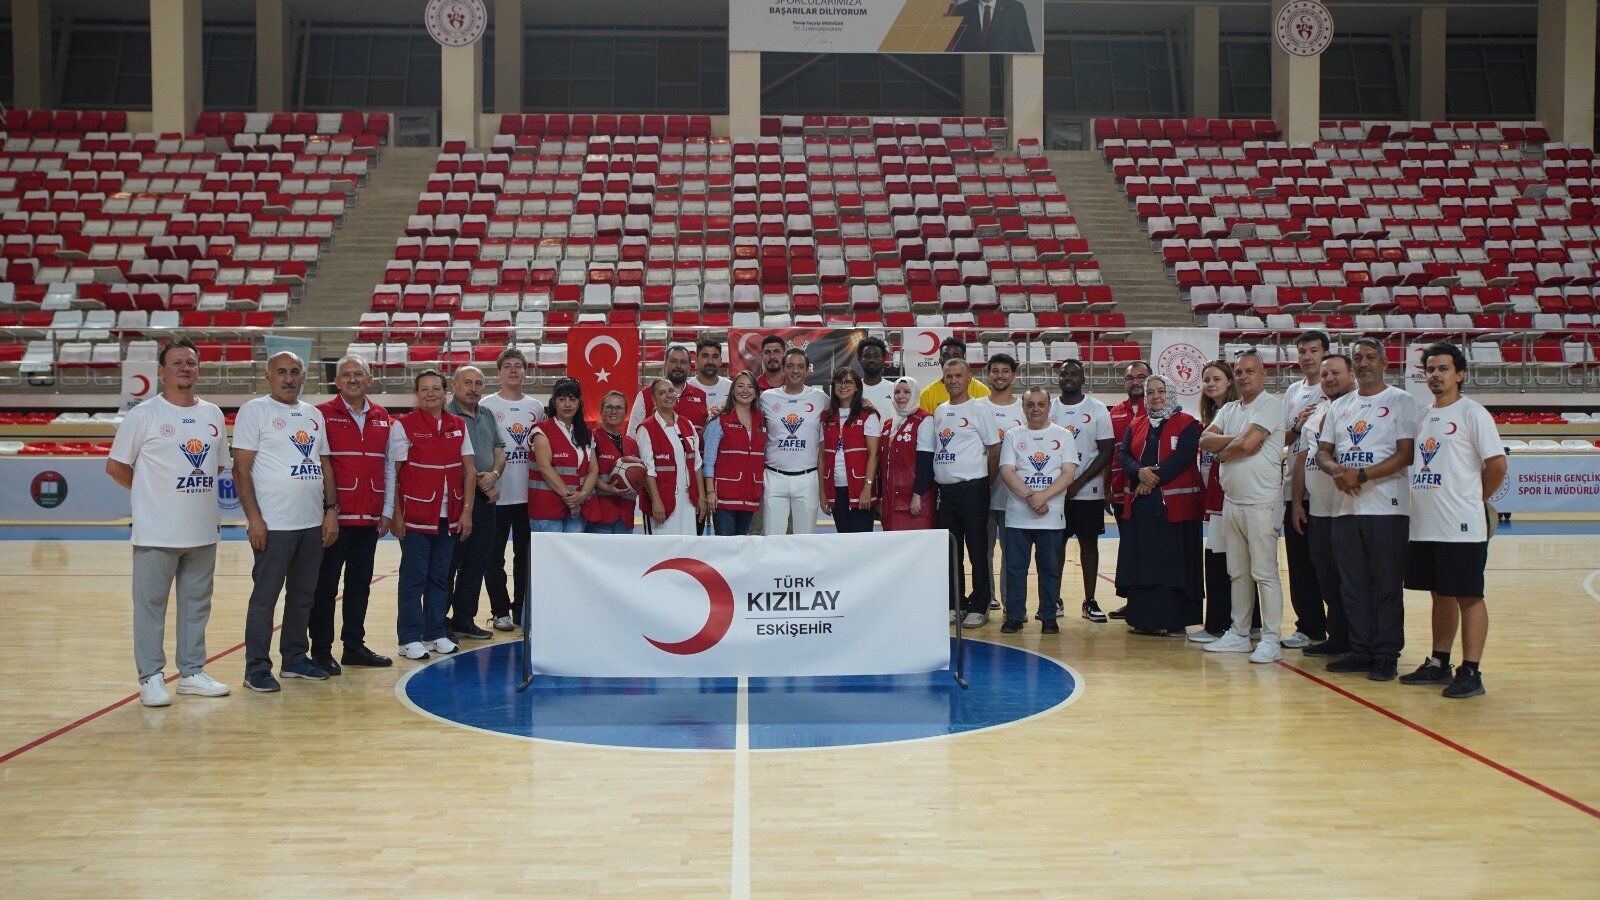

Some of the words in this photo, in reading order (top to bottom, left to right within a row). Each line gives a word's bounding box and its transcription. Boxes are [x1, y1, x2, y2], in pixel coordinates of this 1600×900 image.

[769, 7, 817, 16] BAŞARILAR
[819, 7, 867, 15] DİLİYORUM
[778, 439, 806, 448] ZAFER
[505, 451, 529, 461] ZAFE
[1340, 452, 1374, 464] ZAFER
[176, 476, 214, 489] ZAFER
[1024, 476, 1053, 485] ZAFER
[1518, 472, 1562, 484] ESKİŞEHİR
[1564, 472, 1600, 484] GENÇLİK
[1518, 486, 1541, 495] SPOR
[1544, 484, 1552, 495] İL
[774, 575, 815, 588] TÜRK
[747, 590, 841, 611] KIZILAY
[756, 620, 832, 637] ESKİŞEHİR
